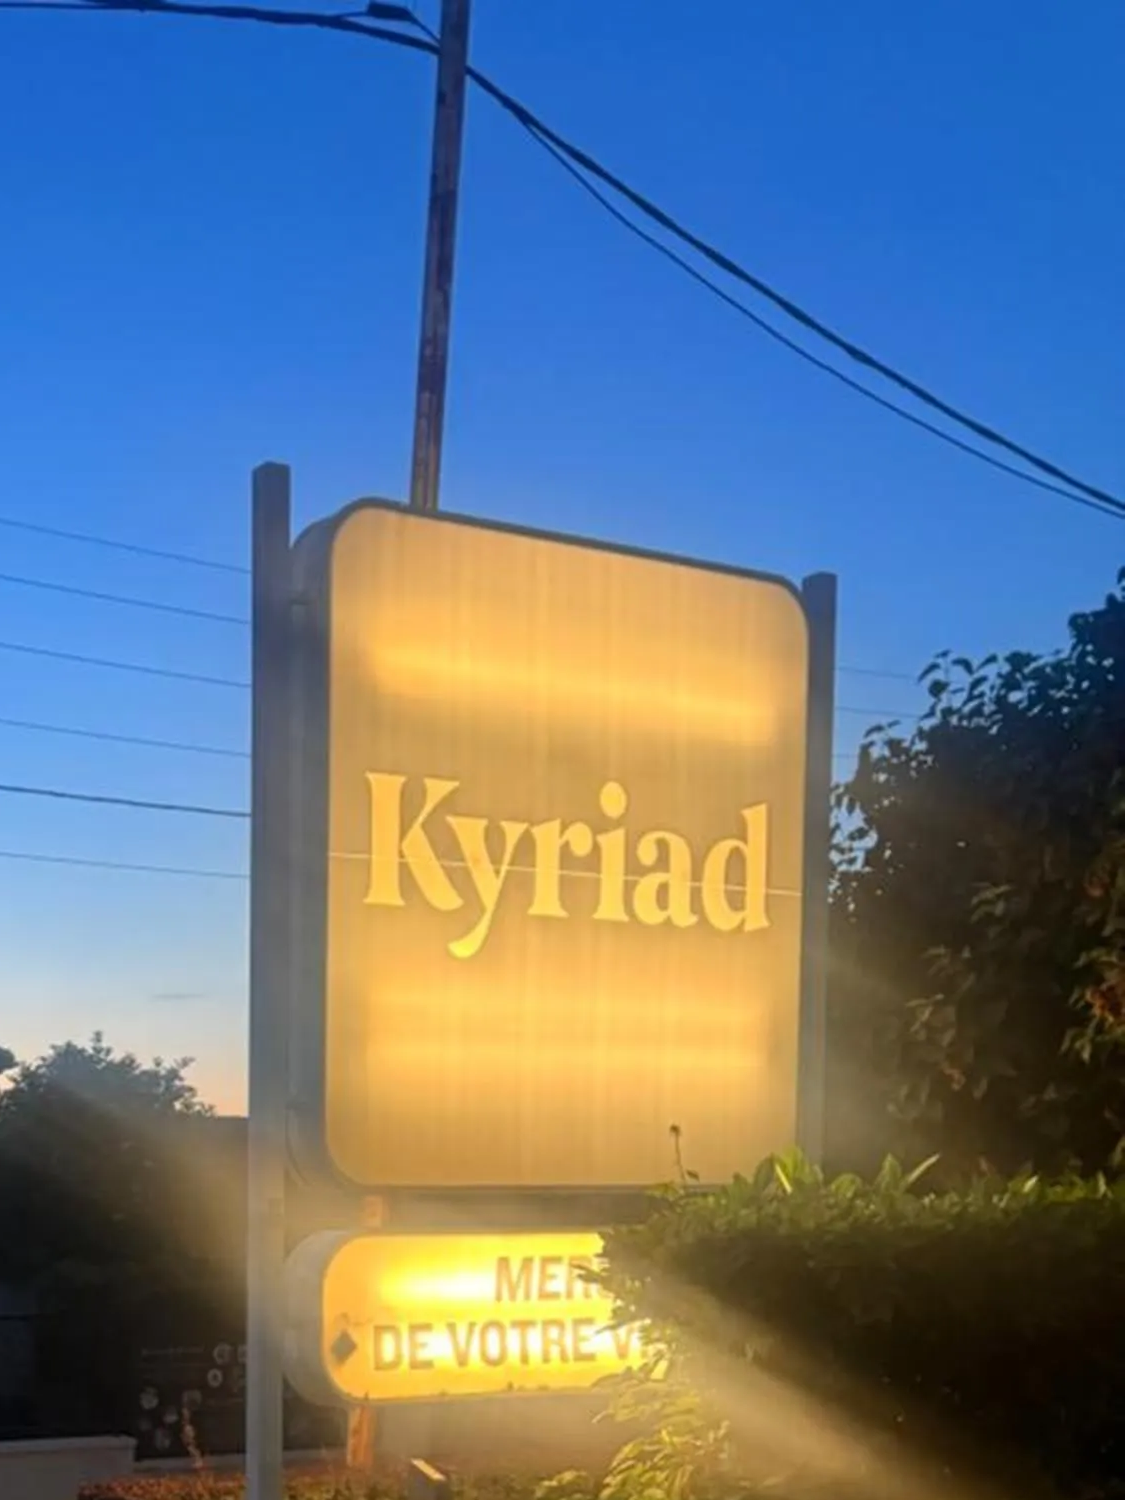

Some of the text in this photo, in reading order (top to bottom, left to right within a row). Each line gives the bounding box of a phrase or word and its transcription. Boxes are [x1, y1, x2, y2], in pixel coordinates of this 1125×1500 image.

[363, 770, 771, 958] Kyriad
[495, 1256, 614, 1302] MER
[374, 1322, 435, 1371] DE
[446, 1317, 598, 1368] VOTRE
